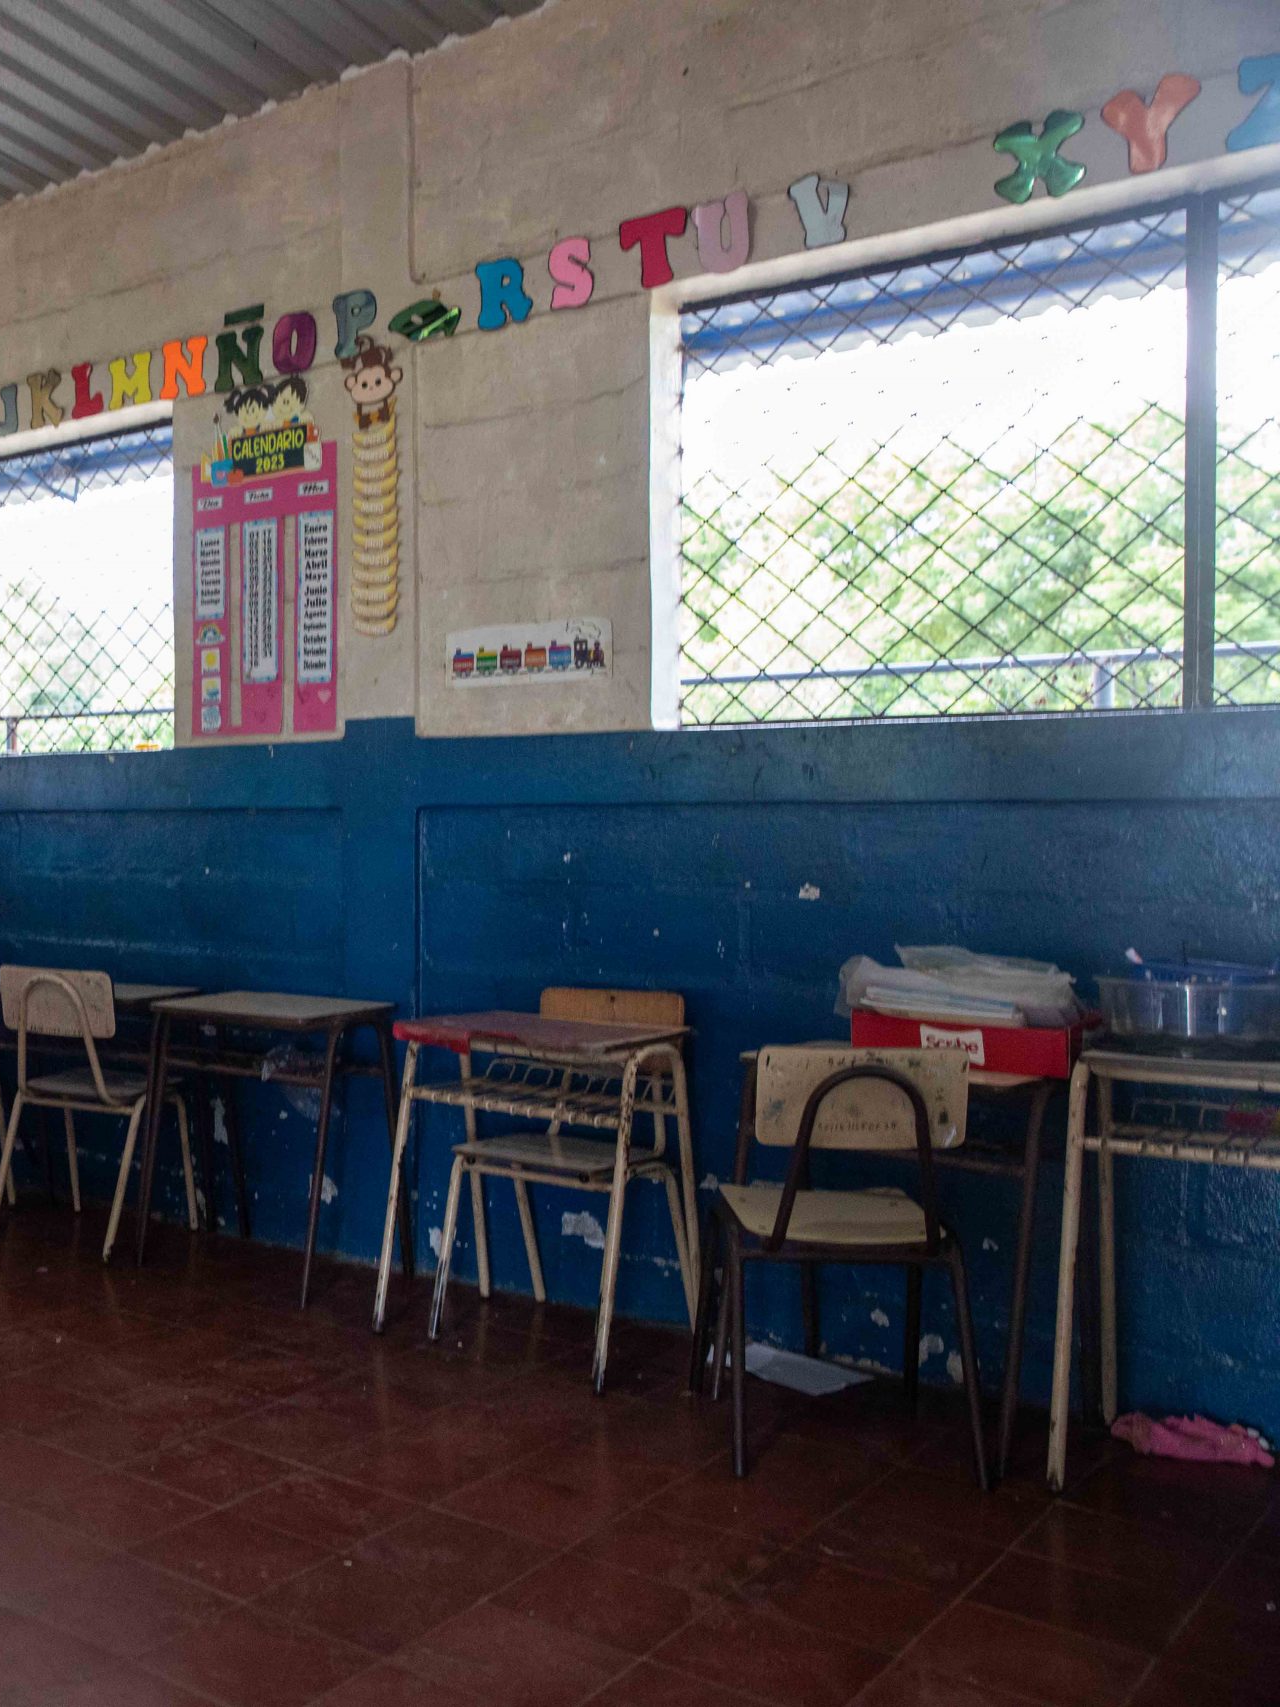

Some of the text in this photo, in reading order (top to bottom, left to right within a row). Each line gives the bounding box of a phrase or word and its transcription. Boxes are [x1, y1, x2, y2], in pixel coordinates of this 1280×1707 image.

[26, 367, 64, 428] K
[71, 362, 104, 419] L
[109, 351, 152, 410] M
[160, 335, 208, 399] N
[215, 303, 265, 391] Ñ
[272, 310, 317, 374] O
[476, 258, 533, 331] R
[548, 236, 594, 310] S
[620, 207, 687, 289] T
[993, 110, 1087, 204] X
[1101, 74, 1201, 175] Y
[234, 428, 304, 461] CALENDARIO
[256, 453, 285, 474] 2023
[304, 522, 328, 535] Enero
[304, 535, 328, 547] Febrero
[304, 548, 328, 559] Marzo
[305, 558, 328, 571] Abril
[304, 571, 328, 582] Mayo
[304, 584, 328, 597] Junio
[304, 597, 327, 608] Julio
[304, 609, 327, 620] Agosto
